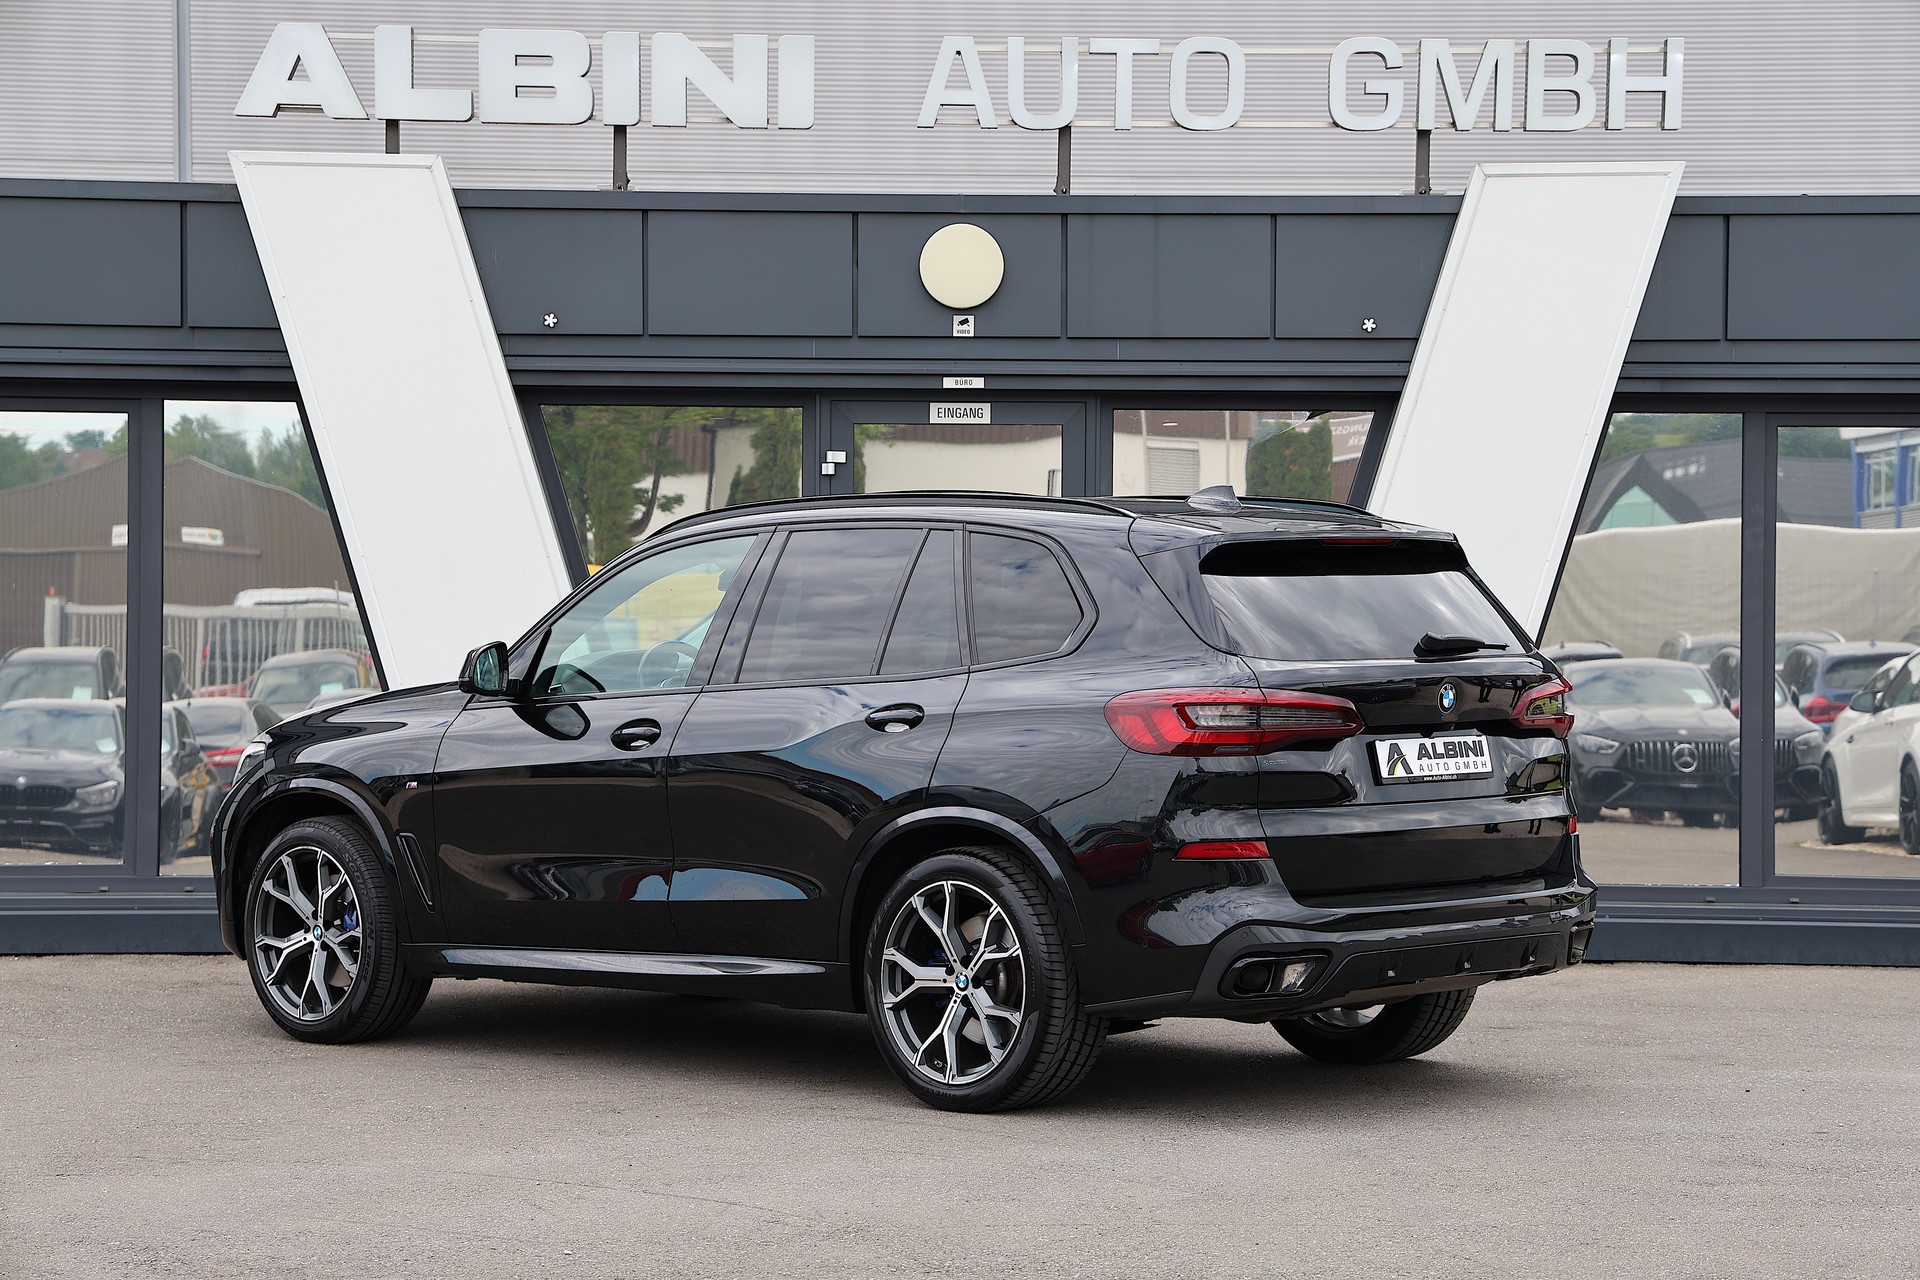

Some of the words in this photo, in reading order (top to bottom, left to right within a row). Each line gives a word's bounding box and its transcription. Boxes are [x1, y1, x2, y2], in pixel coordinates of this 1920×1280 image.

[233, 22, 815, 130] ALBINI
[917, 36, 1247, 132] AUTO
[1328, 36, 1685, 132] GMBH
[954, 378, 973, 386] BÜRO
[937, 407, 984, 419] EINGANG
[1417, 740, 1485, 760] ALBINI
[1419, 762, 1450, 773] AUTO
[1455, 760, 1488, 772] GMBH
